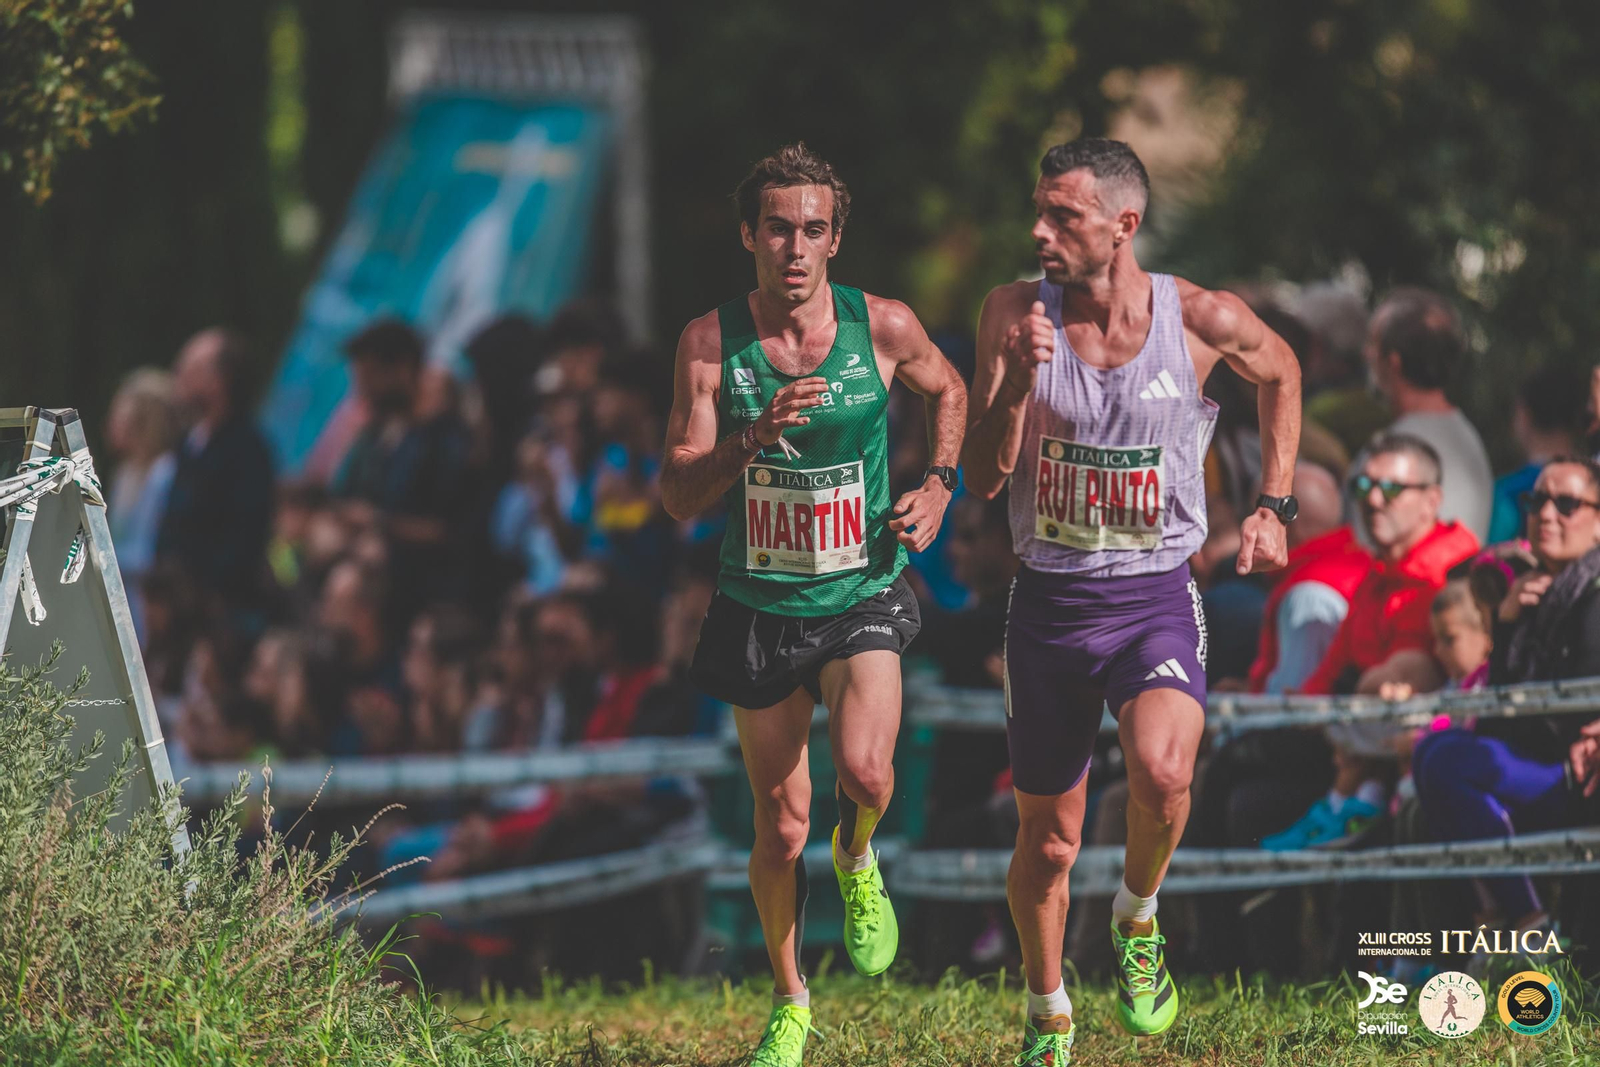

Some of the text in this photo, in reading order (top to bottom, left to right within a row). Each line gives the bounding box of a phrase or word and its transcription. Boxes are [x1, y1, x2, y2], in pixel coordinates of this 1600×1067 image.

[731, 386, 761, 395] rasán
[1072, 447, 1131, 466] ITÁLICA
[779, 472, 833, 488] ITÁLICA
[1037, 459, 1160, 528] RUI PINTO
[748, 487, 862, 553] MARTÍN
[863, 624, 893, 636] rasán
